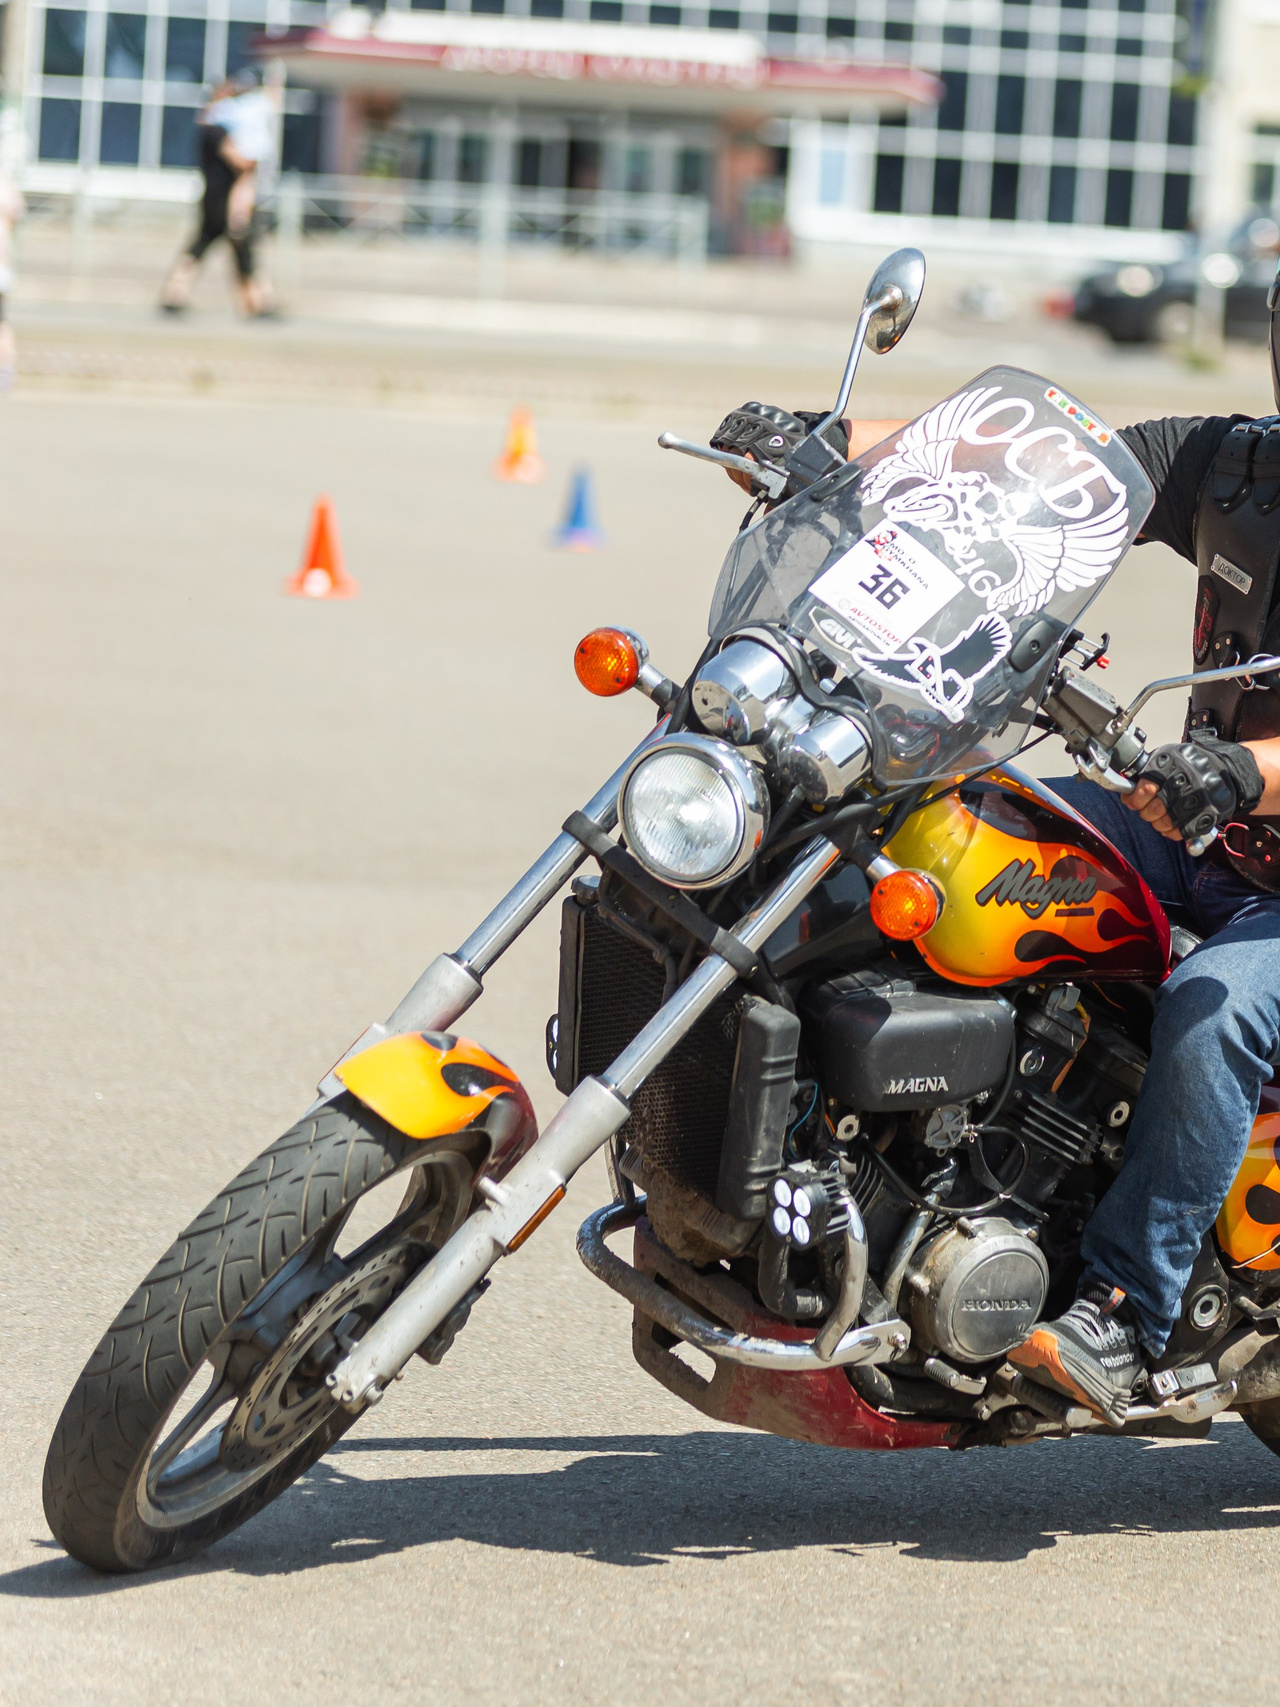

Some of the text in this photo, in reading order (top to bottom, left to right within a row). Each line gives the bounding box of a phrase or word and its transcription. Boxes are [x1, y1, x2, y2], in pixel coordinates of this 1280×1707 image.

[1047, 389, 1069, 409] TE
[888, 541, 916, 565] MOO
[1217, 562, 1246, 586] ДОКТОР
[857, 563, 911, 610] 36
[849, 606, 902, 644] AVTOSTOP
[975, 858, 1097, 920] Magna
[887, 1076, 949, 1094] MAGNA
[961, 1299, 1032, 1311] HONDA
